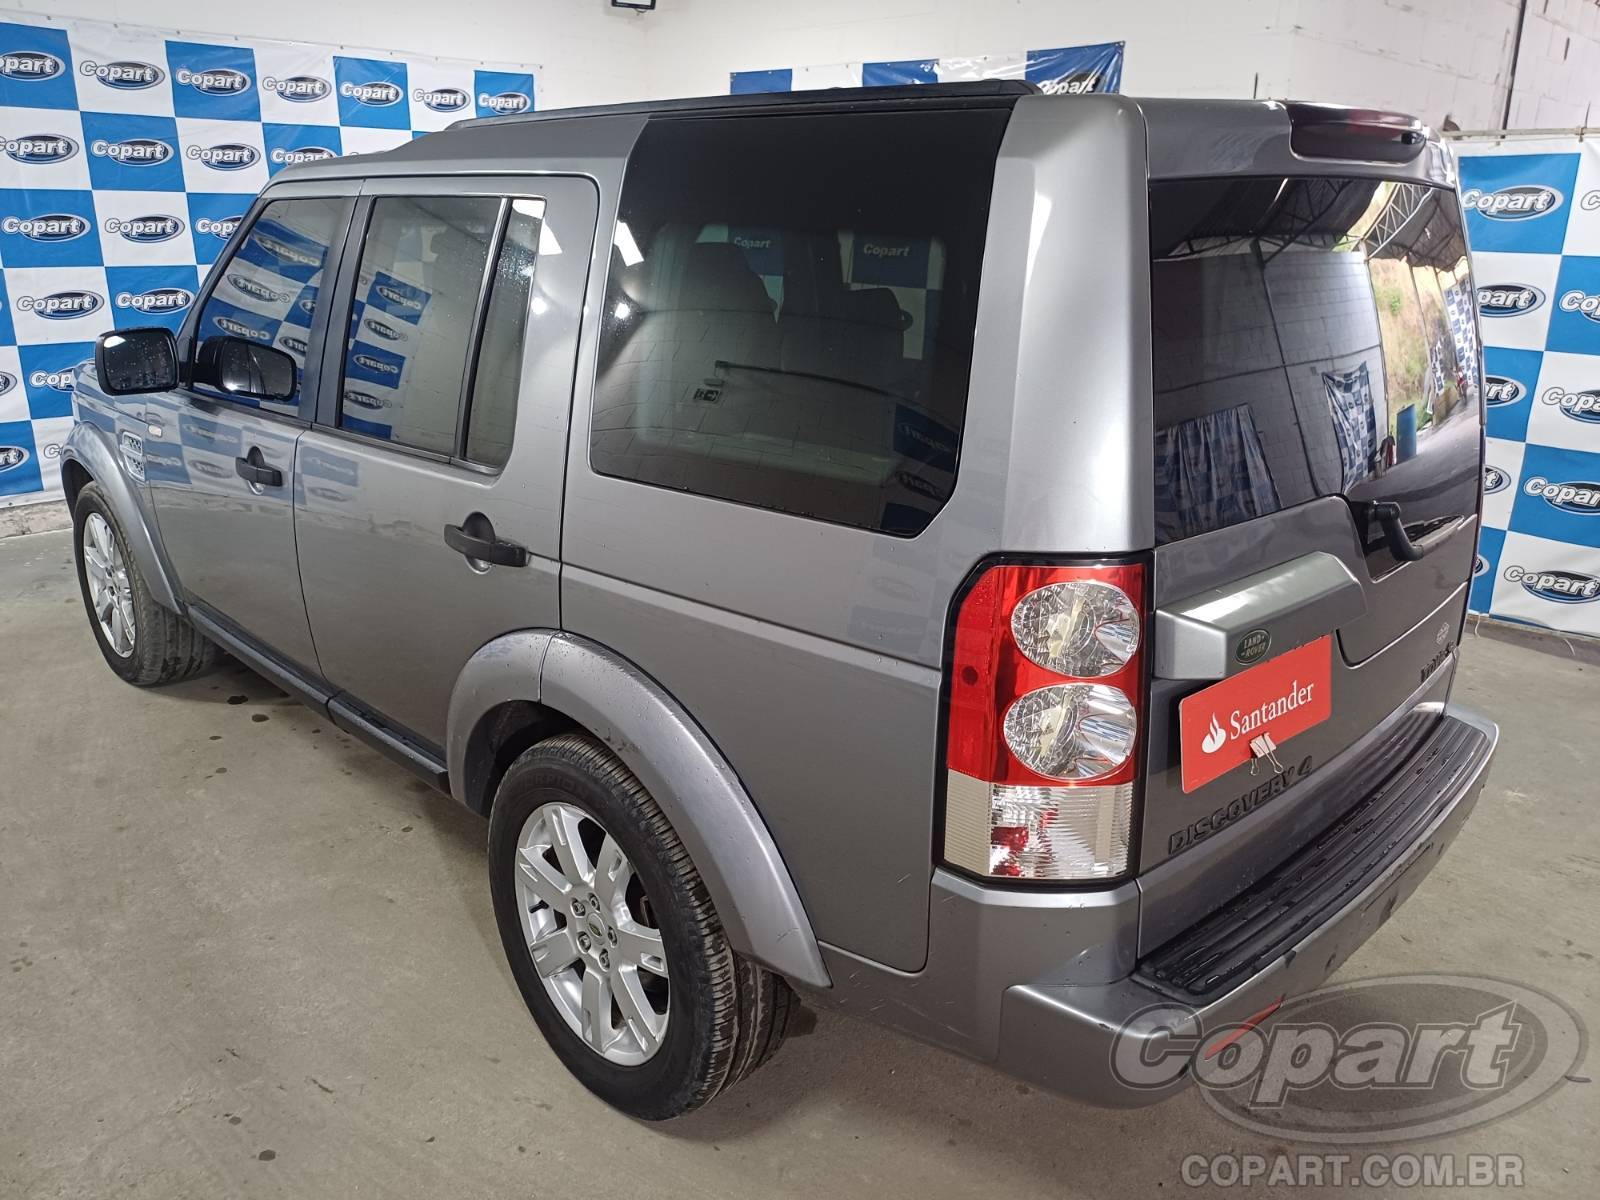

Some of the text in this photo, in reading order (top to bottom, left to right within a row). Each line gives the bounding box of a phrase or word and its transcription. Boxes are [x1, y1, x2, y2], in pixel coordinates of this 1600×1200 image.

[0, 56, 55, 75] part
[80, 60, 154, 84] Copart
[176, 69, 243, 90] Copart
[262, 76, 324, 95] Copart
[340, 82, 397, 101] Copart
[413, 89, 463, 106] Copart
[478, 91, 525, 111] Copart
[92, 140, 165, 162] Copart
[186, 145, 252, 163] Copart
[1462, 189, 1551, 215] Copart
[3, 216, 82, 237] Copart
[105, 218, 178, 237] Copart
[734, 236, 771, 249] Copart
[863, 243, 911, 257] Copart
[17, 293, 94, 311] Copart
[116, 291, 188, 309] Copart
[1504, 565, 1598, 597] Copart
[1243, 633, 1262, 649] LAND
[1229, 679, 1314, 740] Santander
[1168, 755, 1313, 855] DISCOVERY 4
